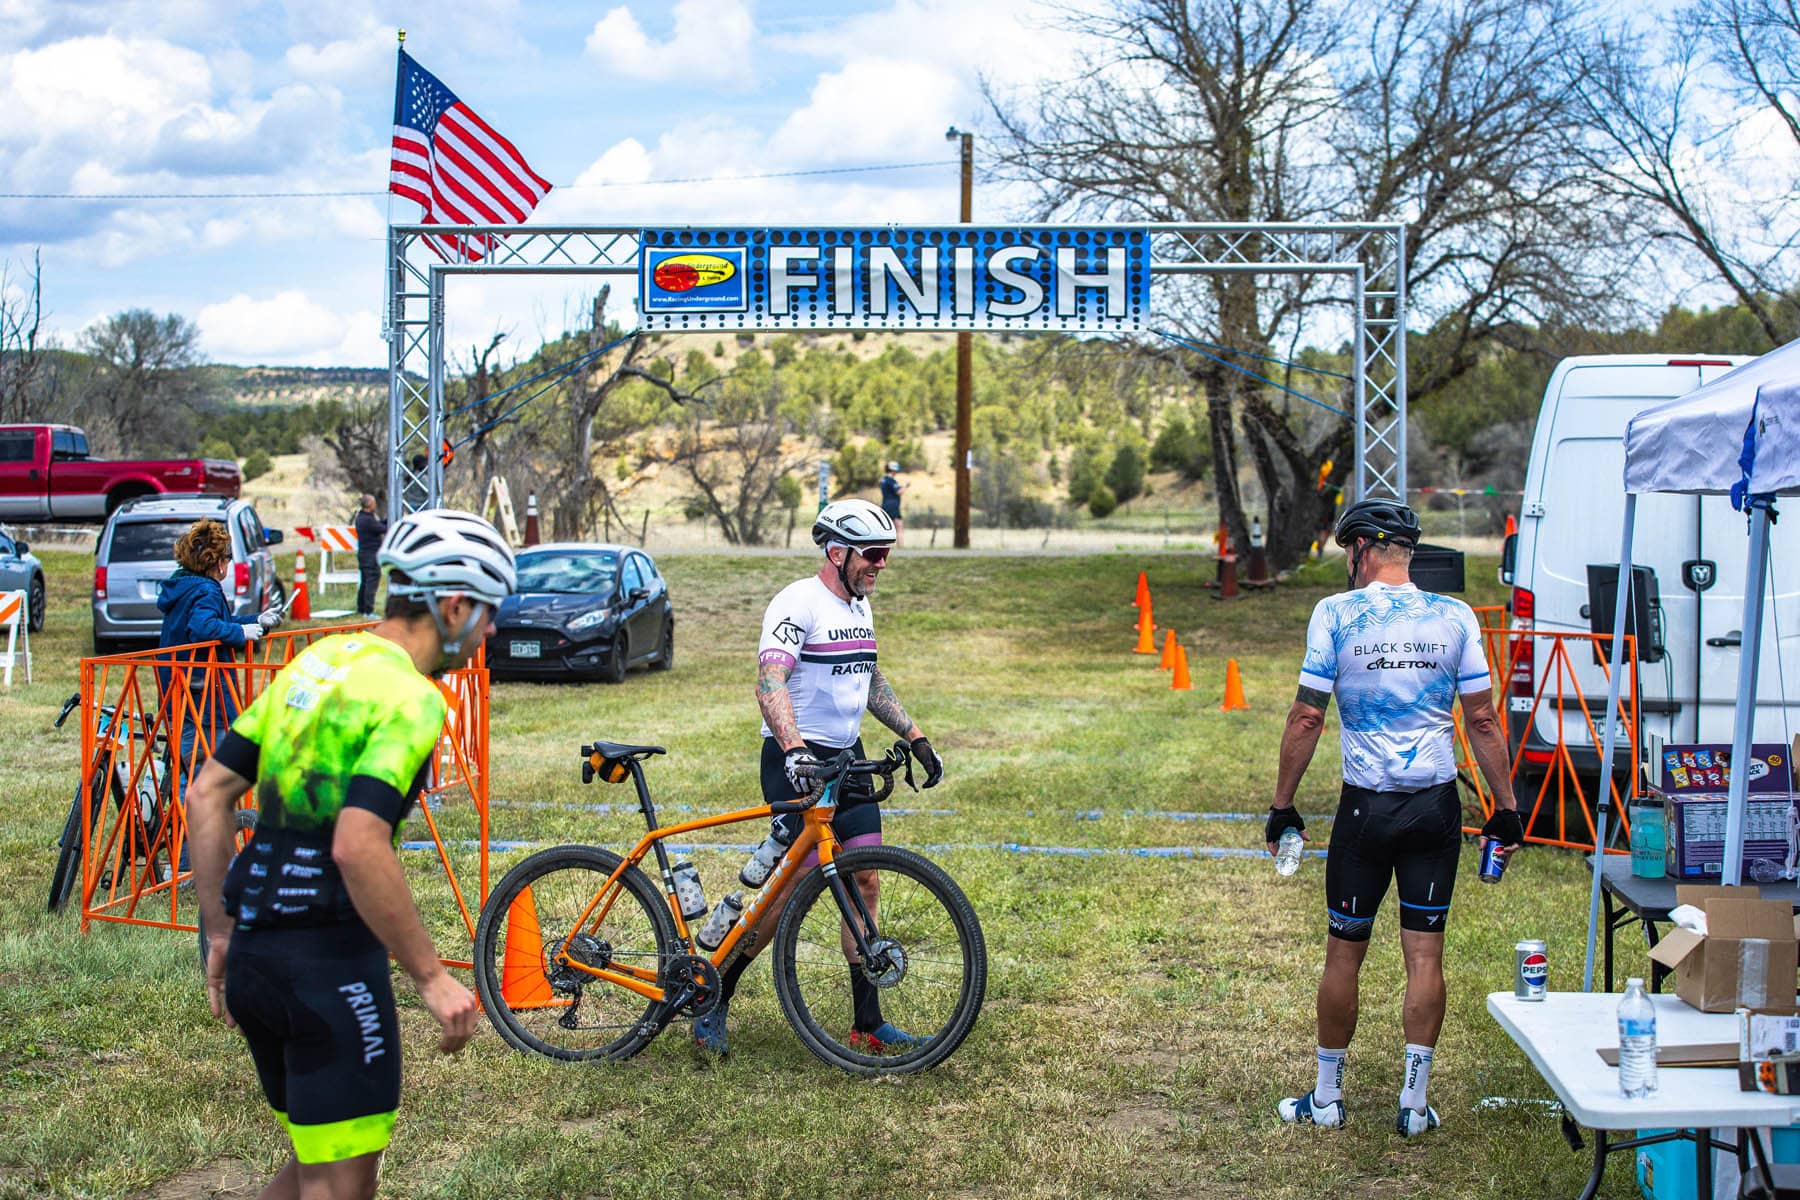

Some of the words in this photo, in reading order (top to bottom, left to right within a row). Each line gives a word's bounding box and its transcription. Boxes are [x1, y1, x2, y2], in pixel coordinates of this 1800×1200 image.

[767, 245, 1128, 319] FINISH
[1354, 642, 1398, 657] BLACK
[1403, 642, 1448, 656] SWIFT
[337, 981, 386, 1065] PRIMAL
